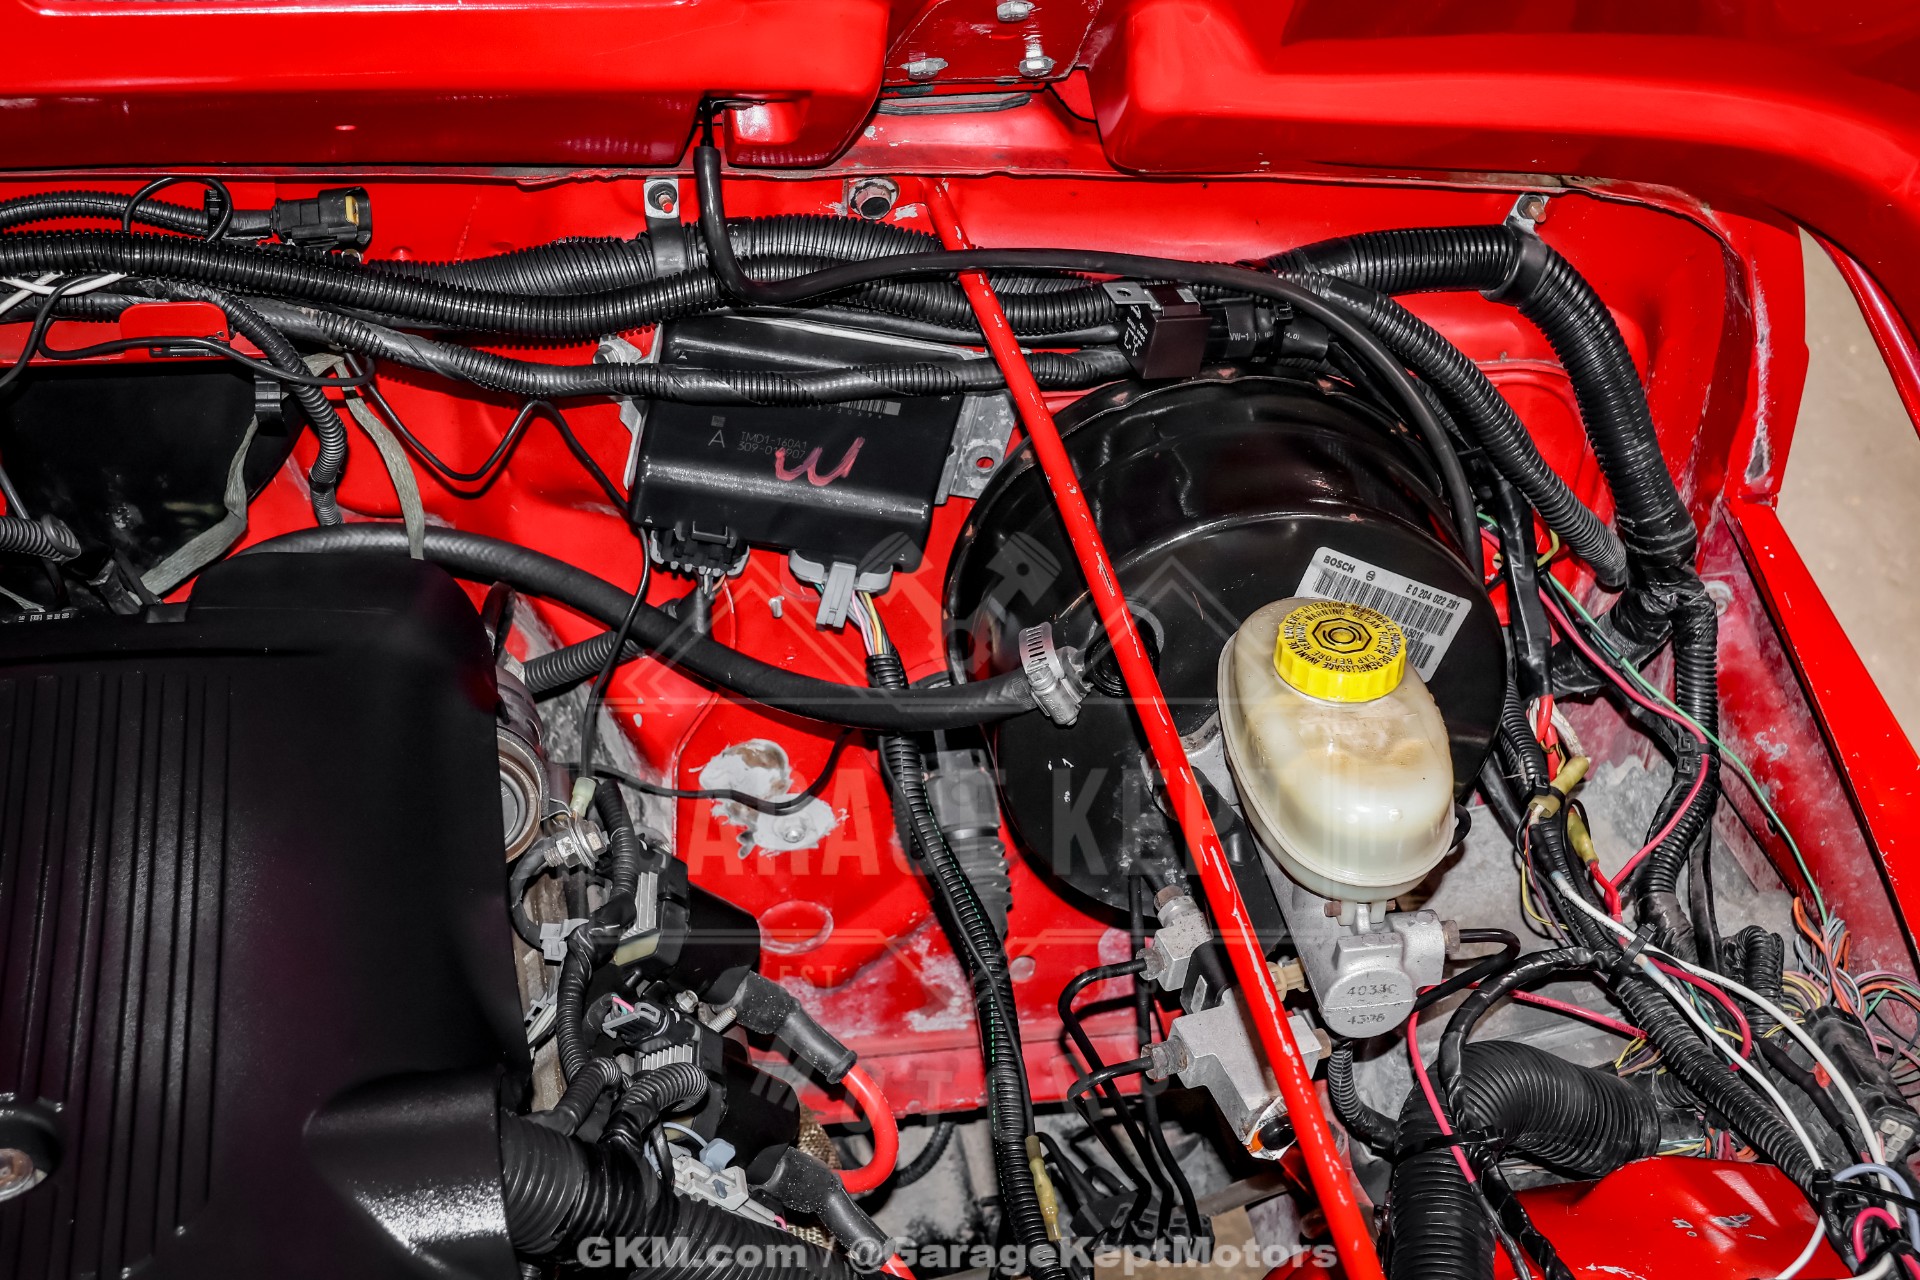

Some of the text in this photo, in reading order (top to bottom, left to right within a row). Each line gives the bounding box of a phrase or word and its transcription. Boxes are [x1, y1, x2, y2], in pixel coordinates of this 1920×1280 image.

[707, 429, 726, 449] A
[1323, 554, 1356, 574] BOSCH
[1405, 583, 1413, 594] E
[1418, 588, 1433, 601] 204
[1433, 594, 1447, 607] 022
[1305, 608, 1345, 622] WARNING
[1358, 653, 1377, 664] CAP
